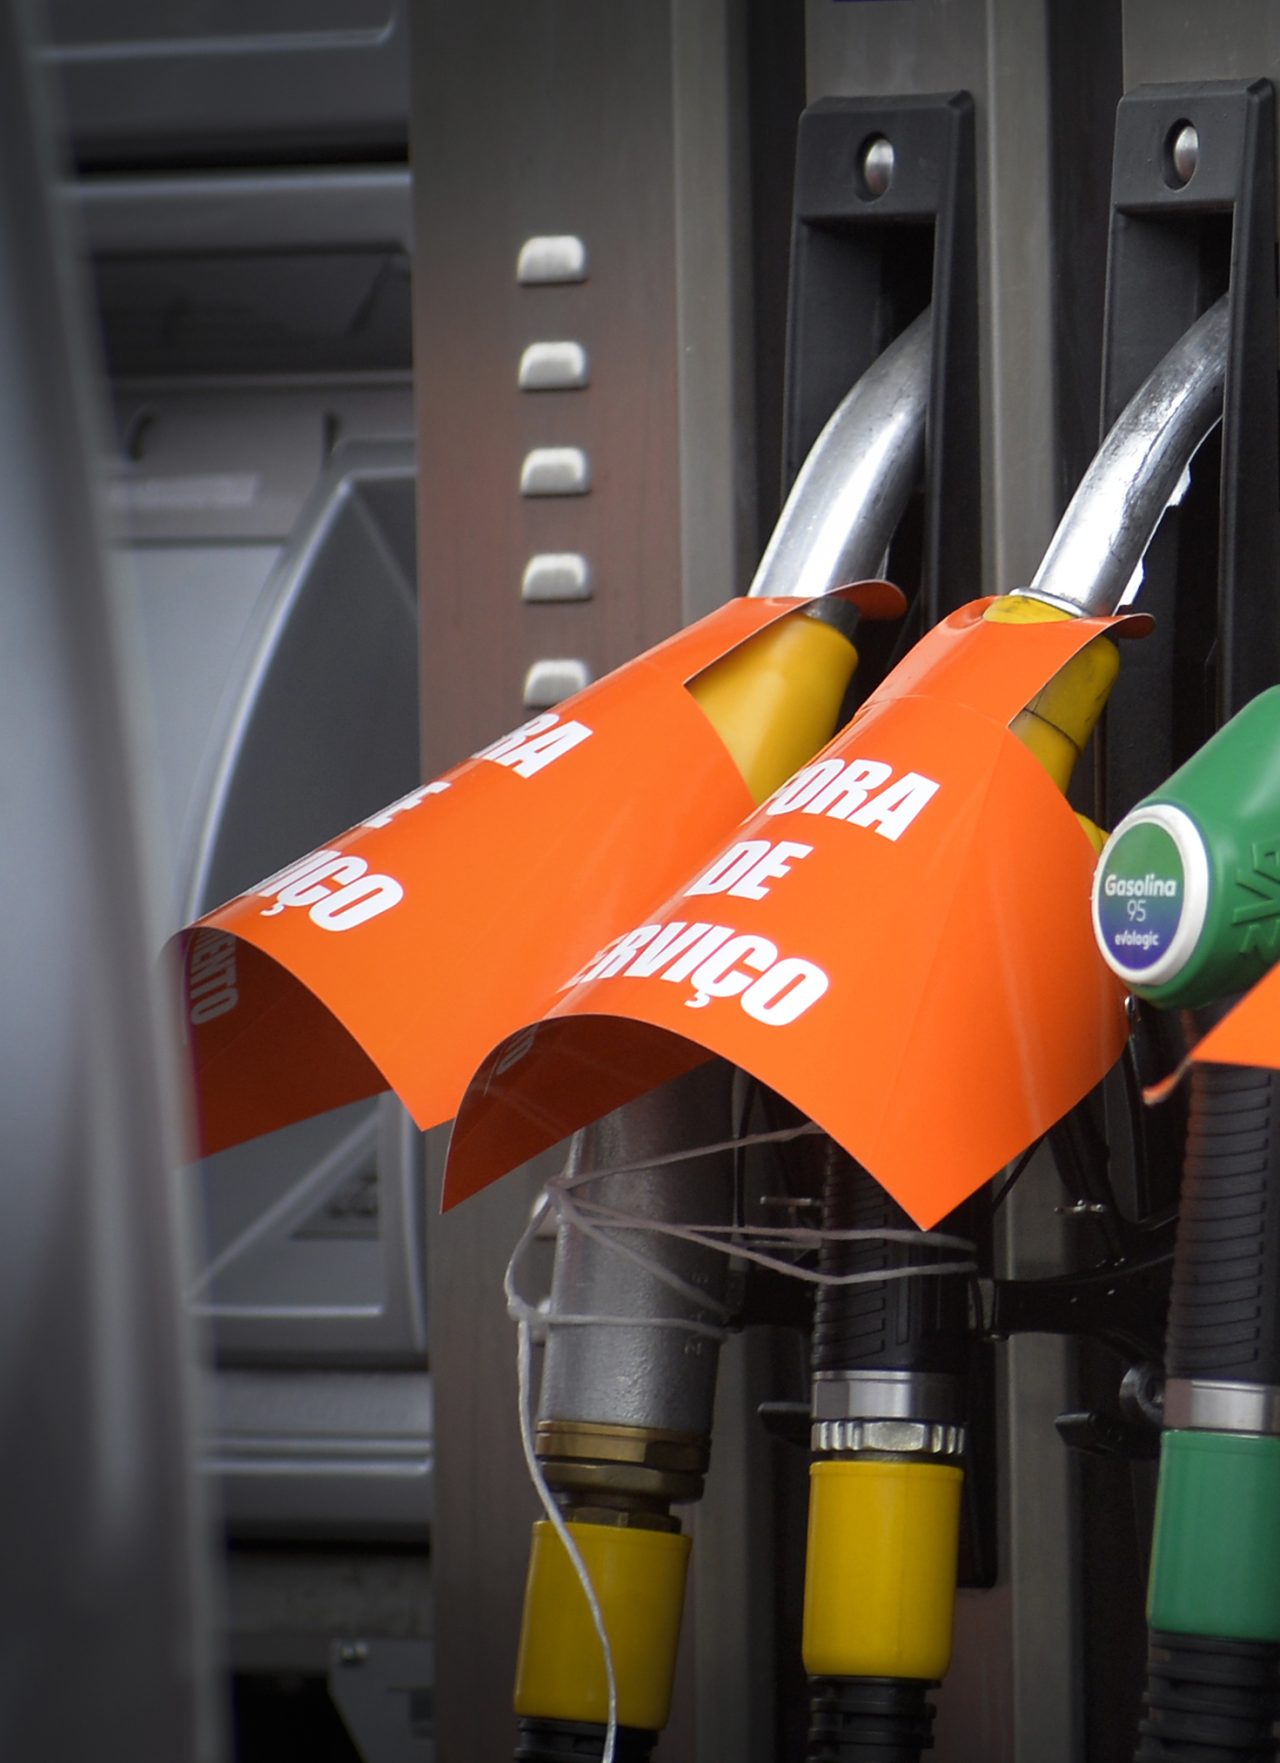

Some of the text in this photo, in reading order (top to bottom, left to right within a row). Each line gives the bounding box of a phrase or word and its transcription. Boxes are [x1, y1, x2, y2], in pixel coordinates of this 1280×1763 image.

[684, 840, 814, 901] DE
[1104, 874, 1178, 897] Gasolina
[1126, 900, 1147, 922] 95
[1114, 930, 1160, 950] evologic
